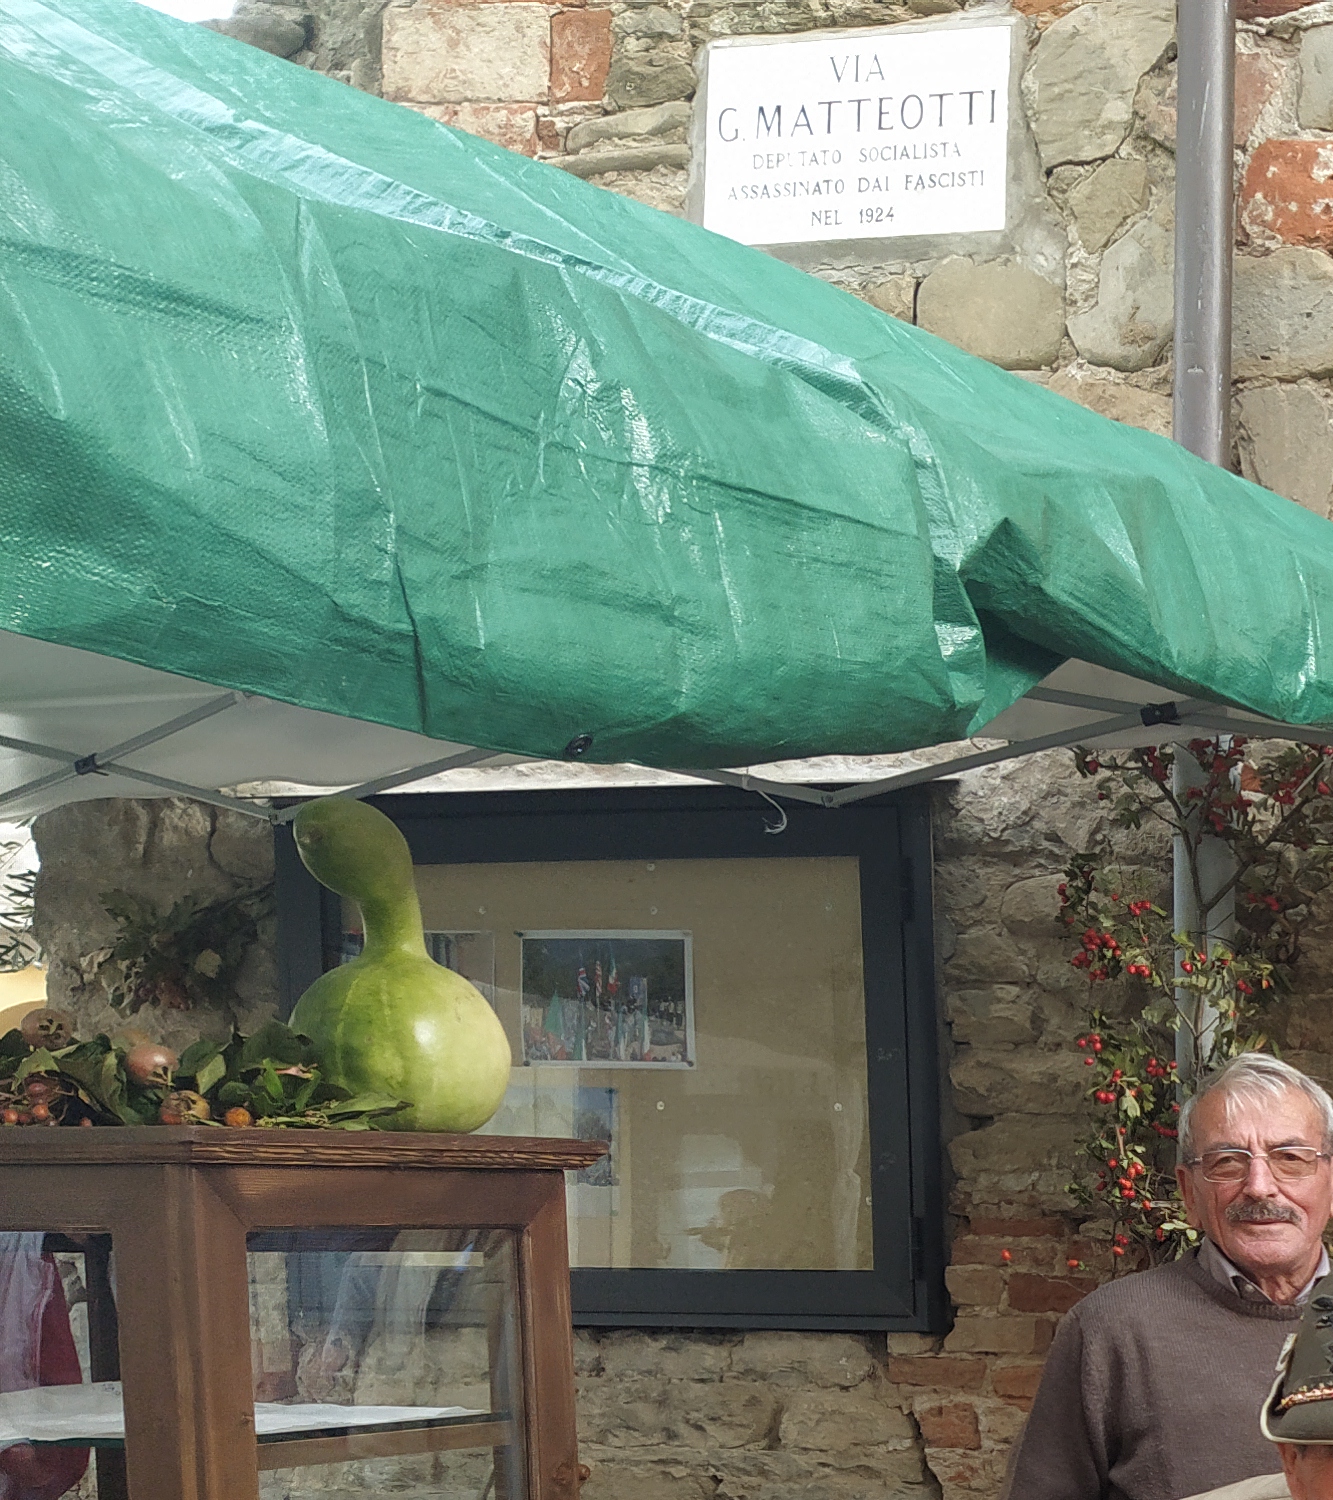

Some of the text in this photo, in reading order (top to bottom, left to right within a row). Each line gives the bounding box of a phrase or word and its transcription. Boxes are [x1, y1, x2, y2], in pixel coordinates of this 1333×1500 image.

[829, 53, 886, 83] VIA
[755, 88, 997, 140] MATTEOTTI
[858, 141, 962, 164] SOCIALISTA
[727, 169, 986, 201] ASSASSINATO DAI FASCISTI
[810, 206, 895, 227] NEL 1924
